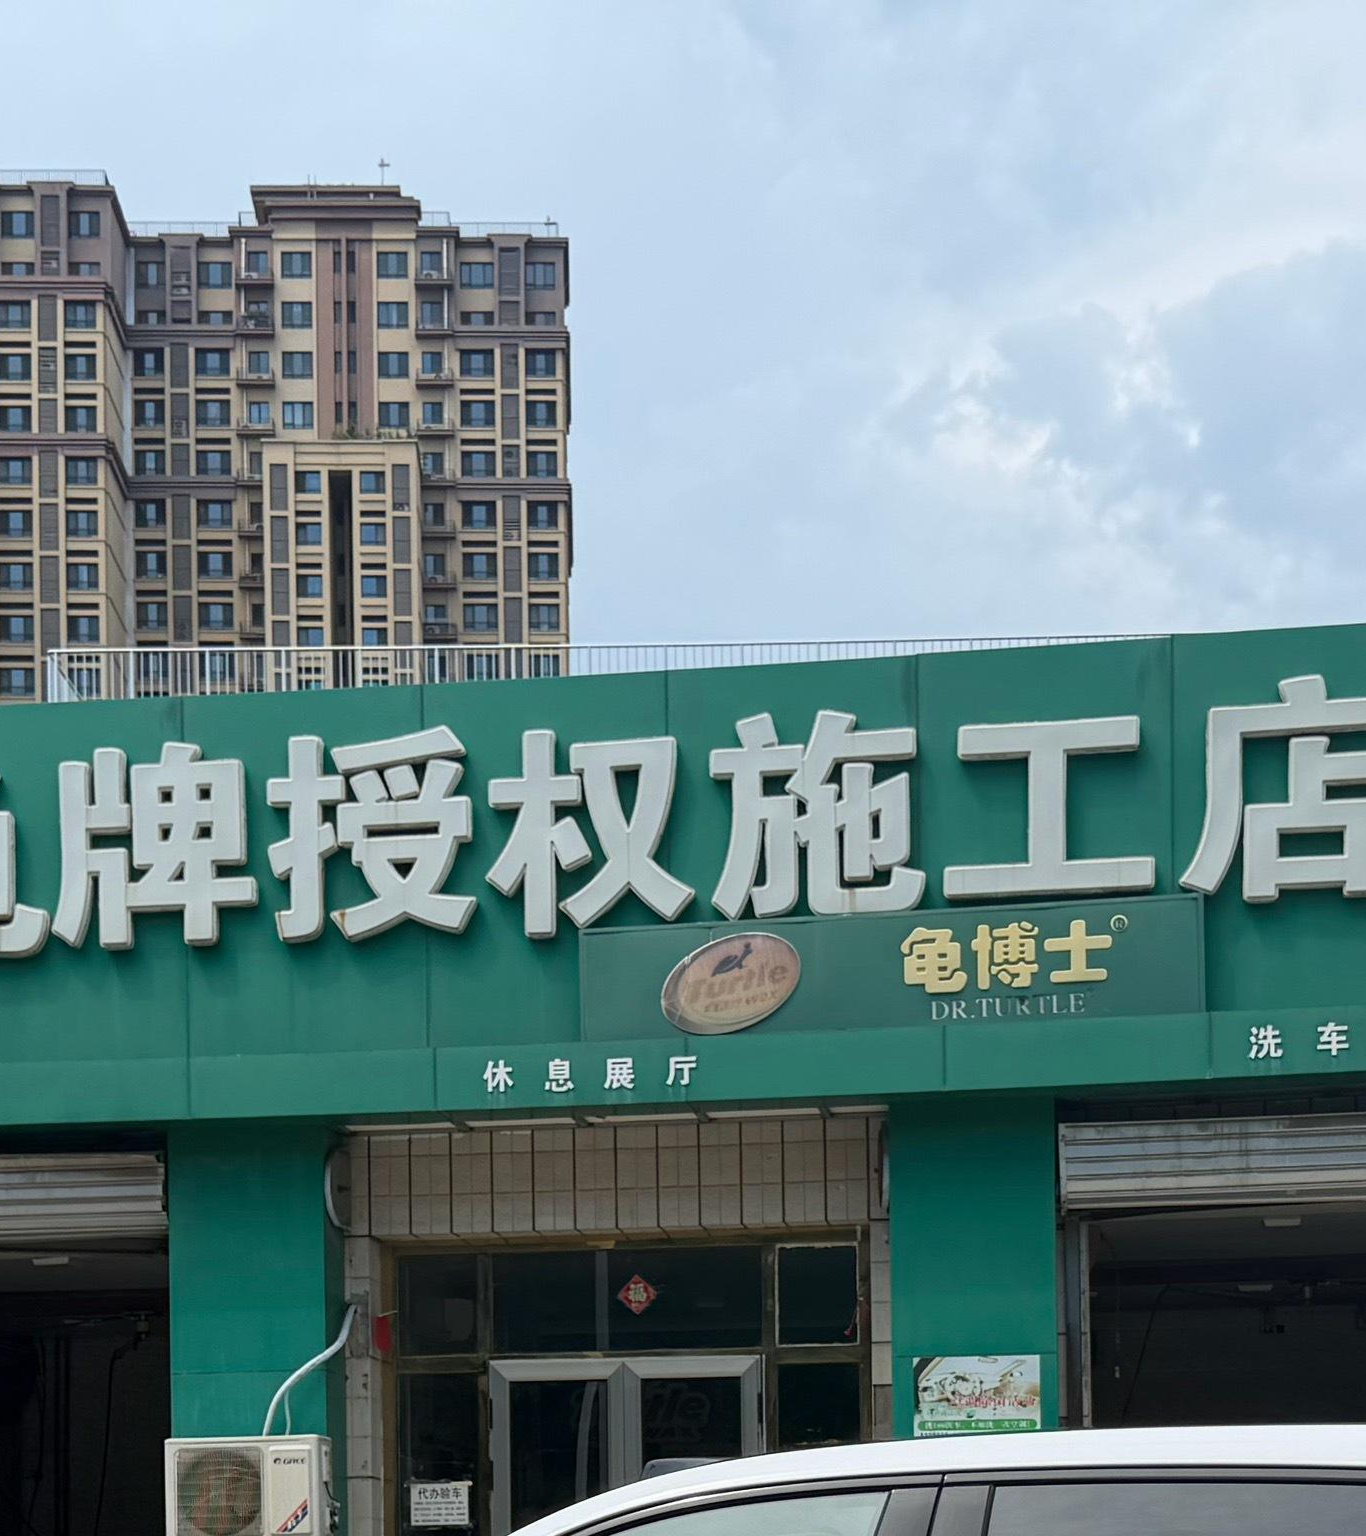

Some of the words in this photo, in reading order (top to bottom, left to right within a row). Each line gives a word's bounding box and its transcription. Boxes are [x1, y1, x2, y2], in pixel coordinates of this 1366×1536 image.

[900, 919, 1113, 994] 龟博士
[931, 992, 1086, 1021] DR.TURTLE
[483, 1055, 699, 1094] 休息展厅
[418, 1487, 463, 1500] 代办验车
